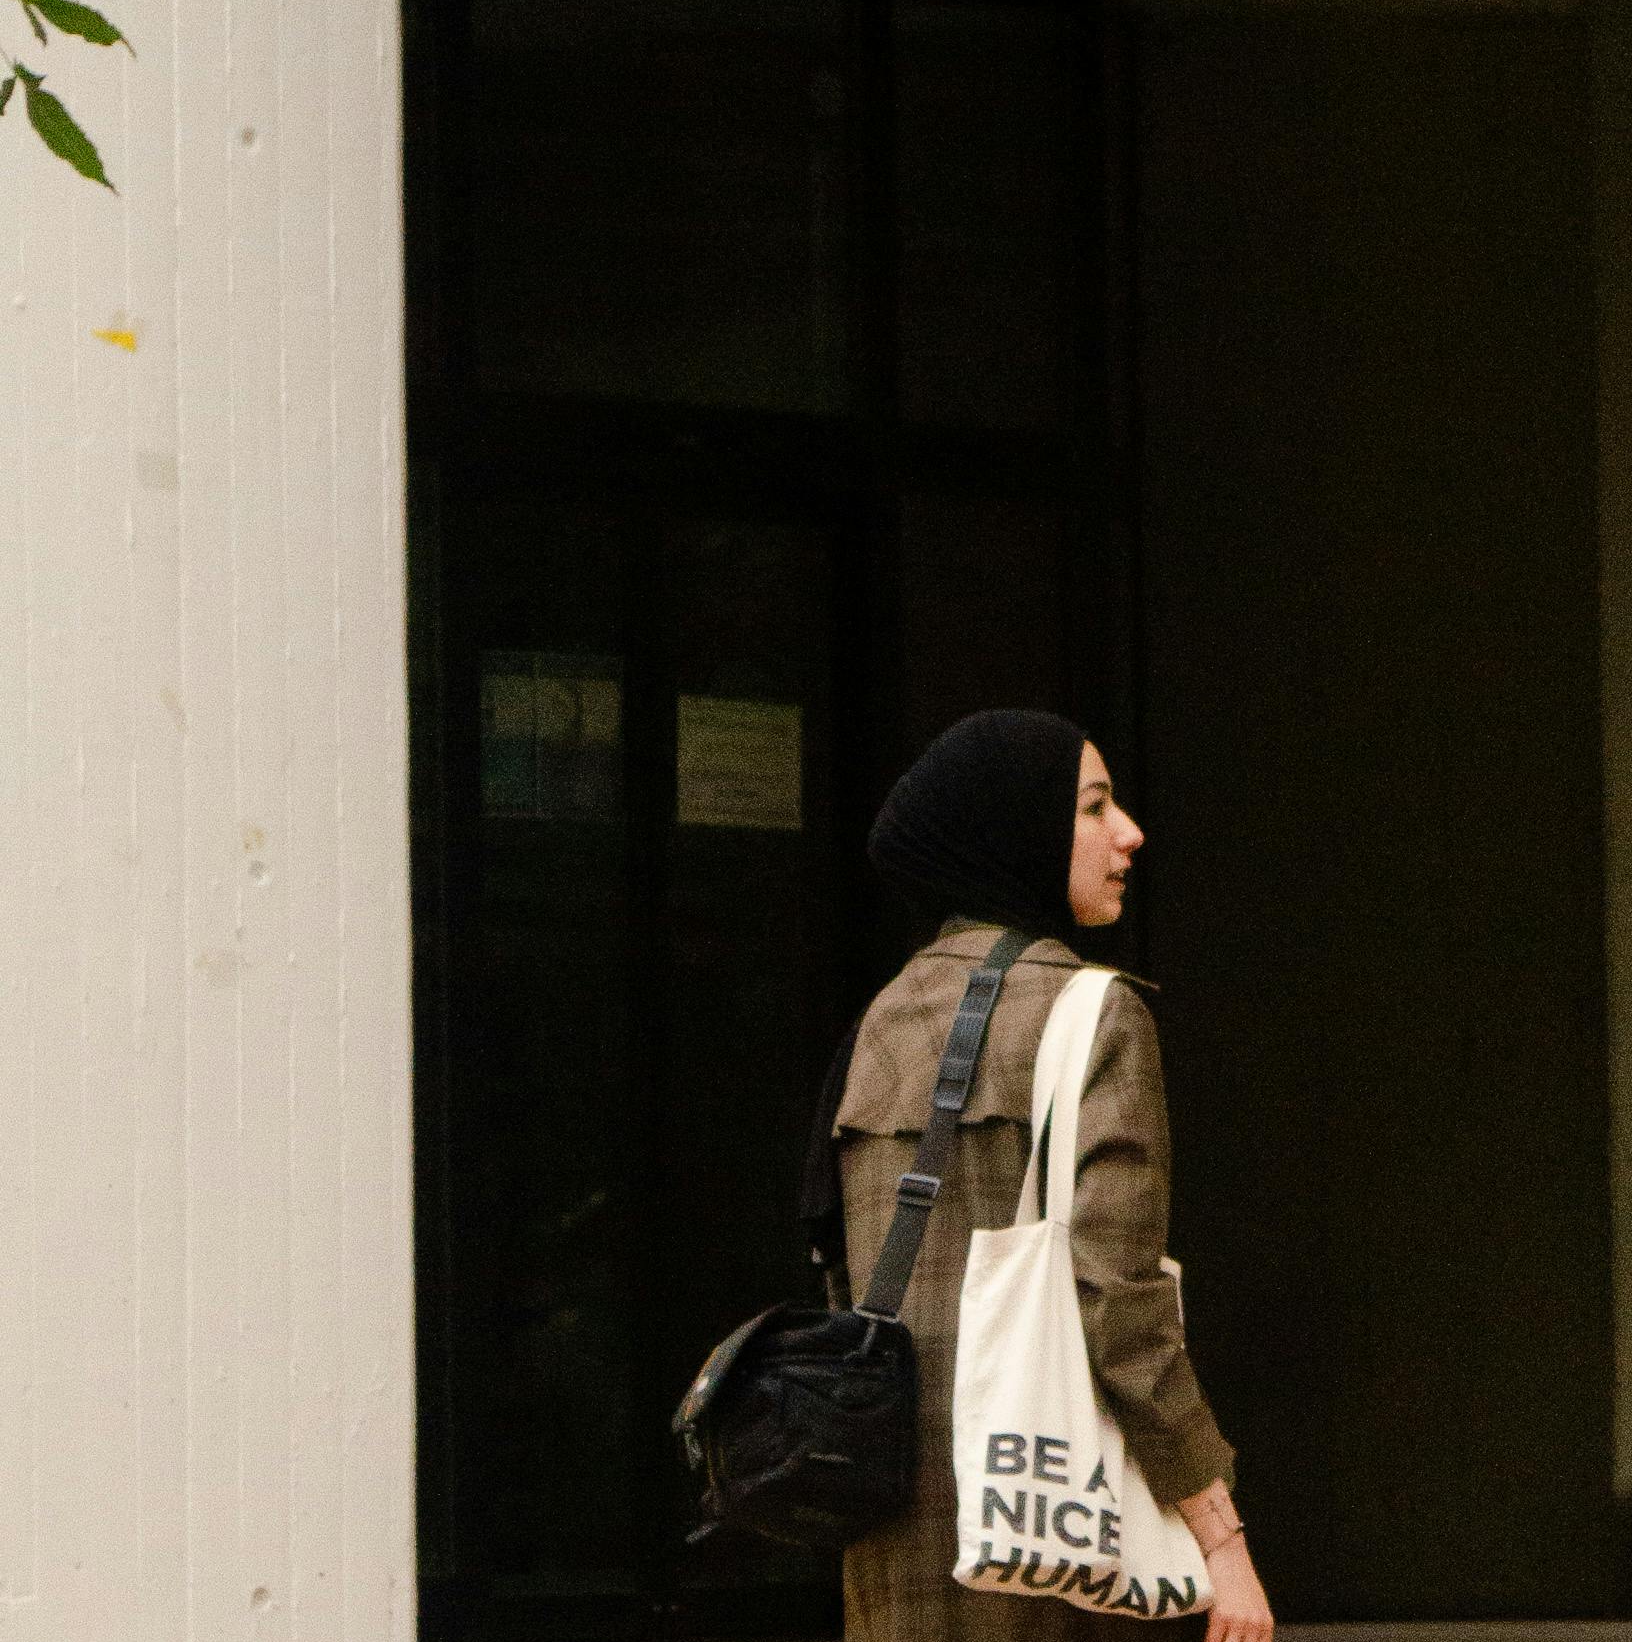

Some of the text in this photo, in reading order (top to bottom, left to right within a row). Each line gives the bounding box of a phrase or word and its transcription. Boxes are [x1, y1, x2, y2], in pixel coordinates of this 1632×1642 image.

[985, 1433, 1118, 1503] BE A
[981, 1486, 1122, 1557] NICE
[972, 1541, 1197, 1617] HUMAN
